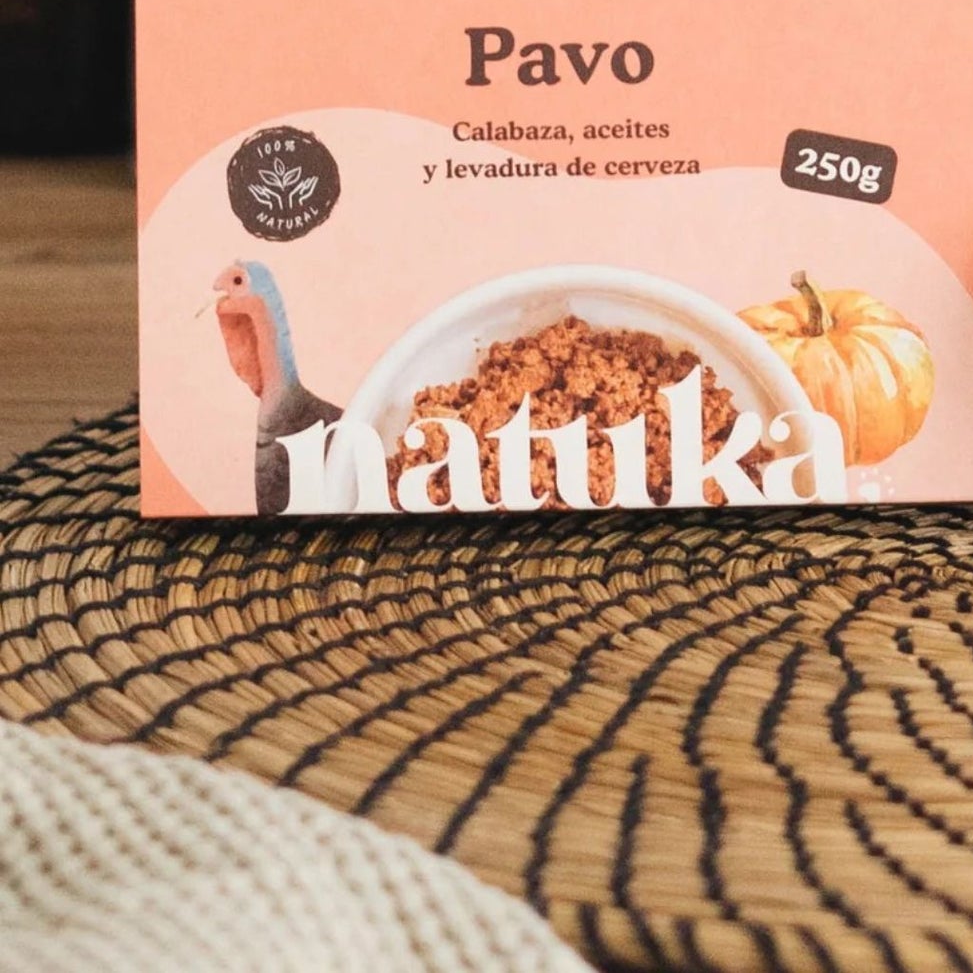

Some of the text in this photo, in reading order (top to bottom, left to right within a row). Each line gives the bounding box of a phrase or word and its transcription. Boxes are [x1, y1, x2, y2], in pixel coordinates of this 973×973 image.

[464, 26, 655, 87] Pavo
[452, 119, 670, 145] Calabaza, aceites
[257, 140, 295, 158] 100%
[422, 154, 701, 183] y levadura de cerveza
[793, 147, 883, 194] 250g
[256, 207, 318, 230] NATURAL
[276, 364, 848, 515] natuka
